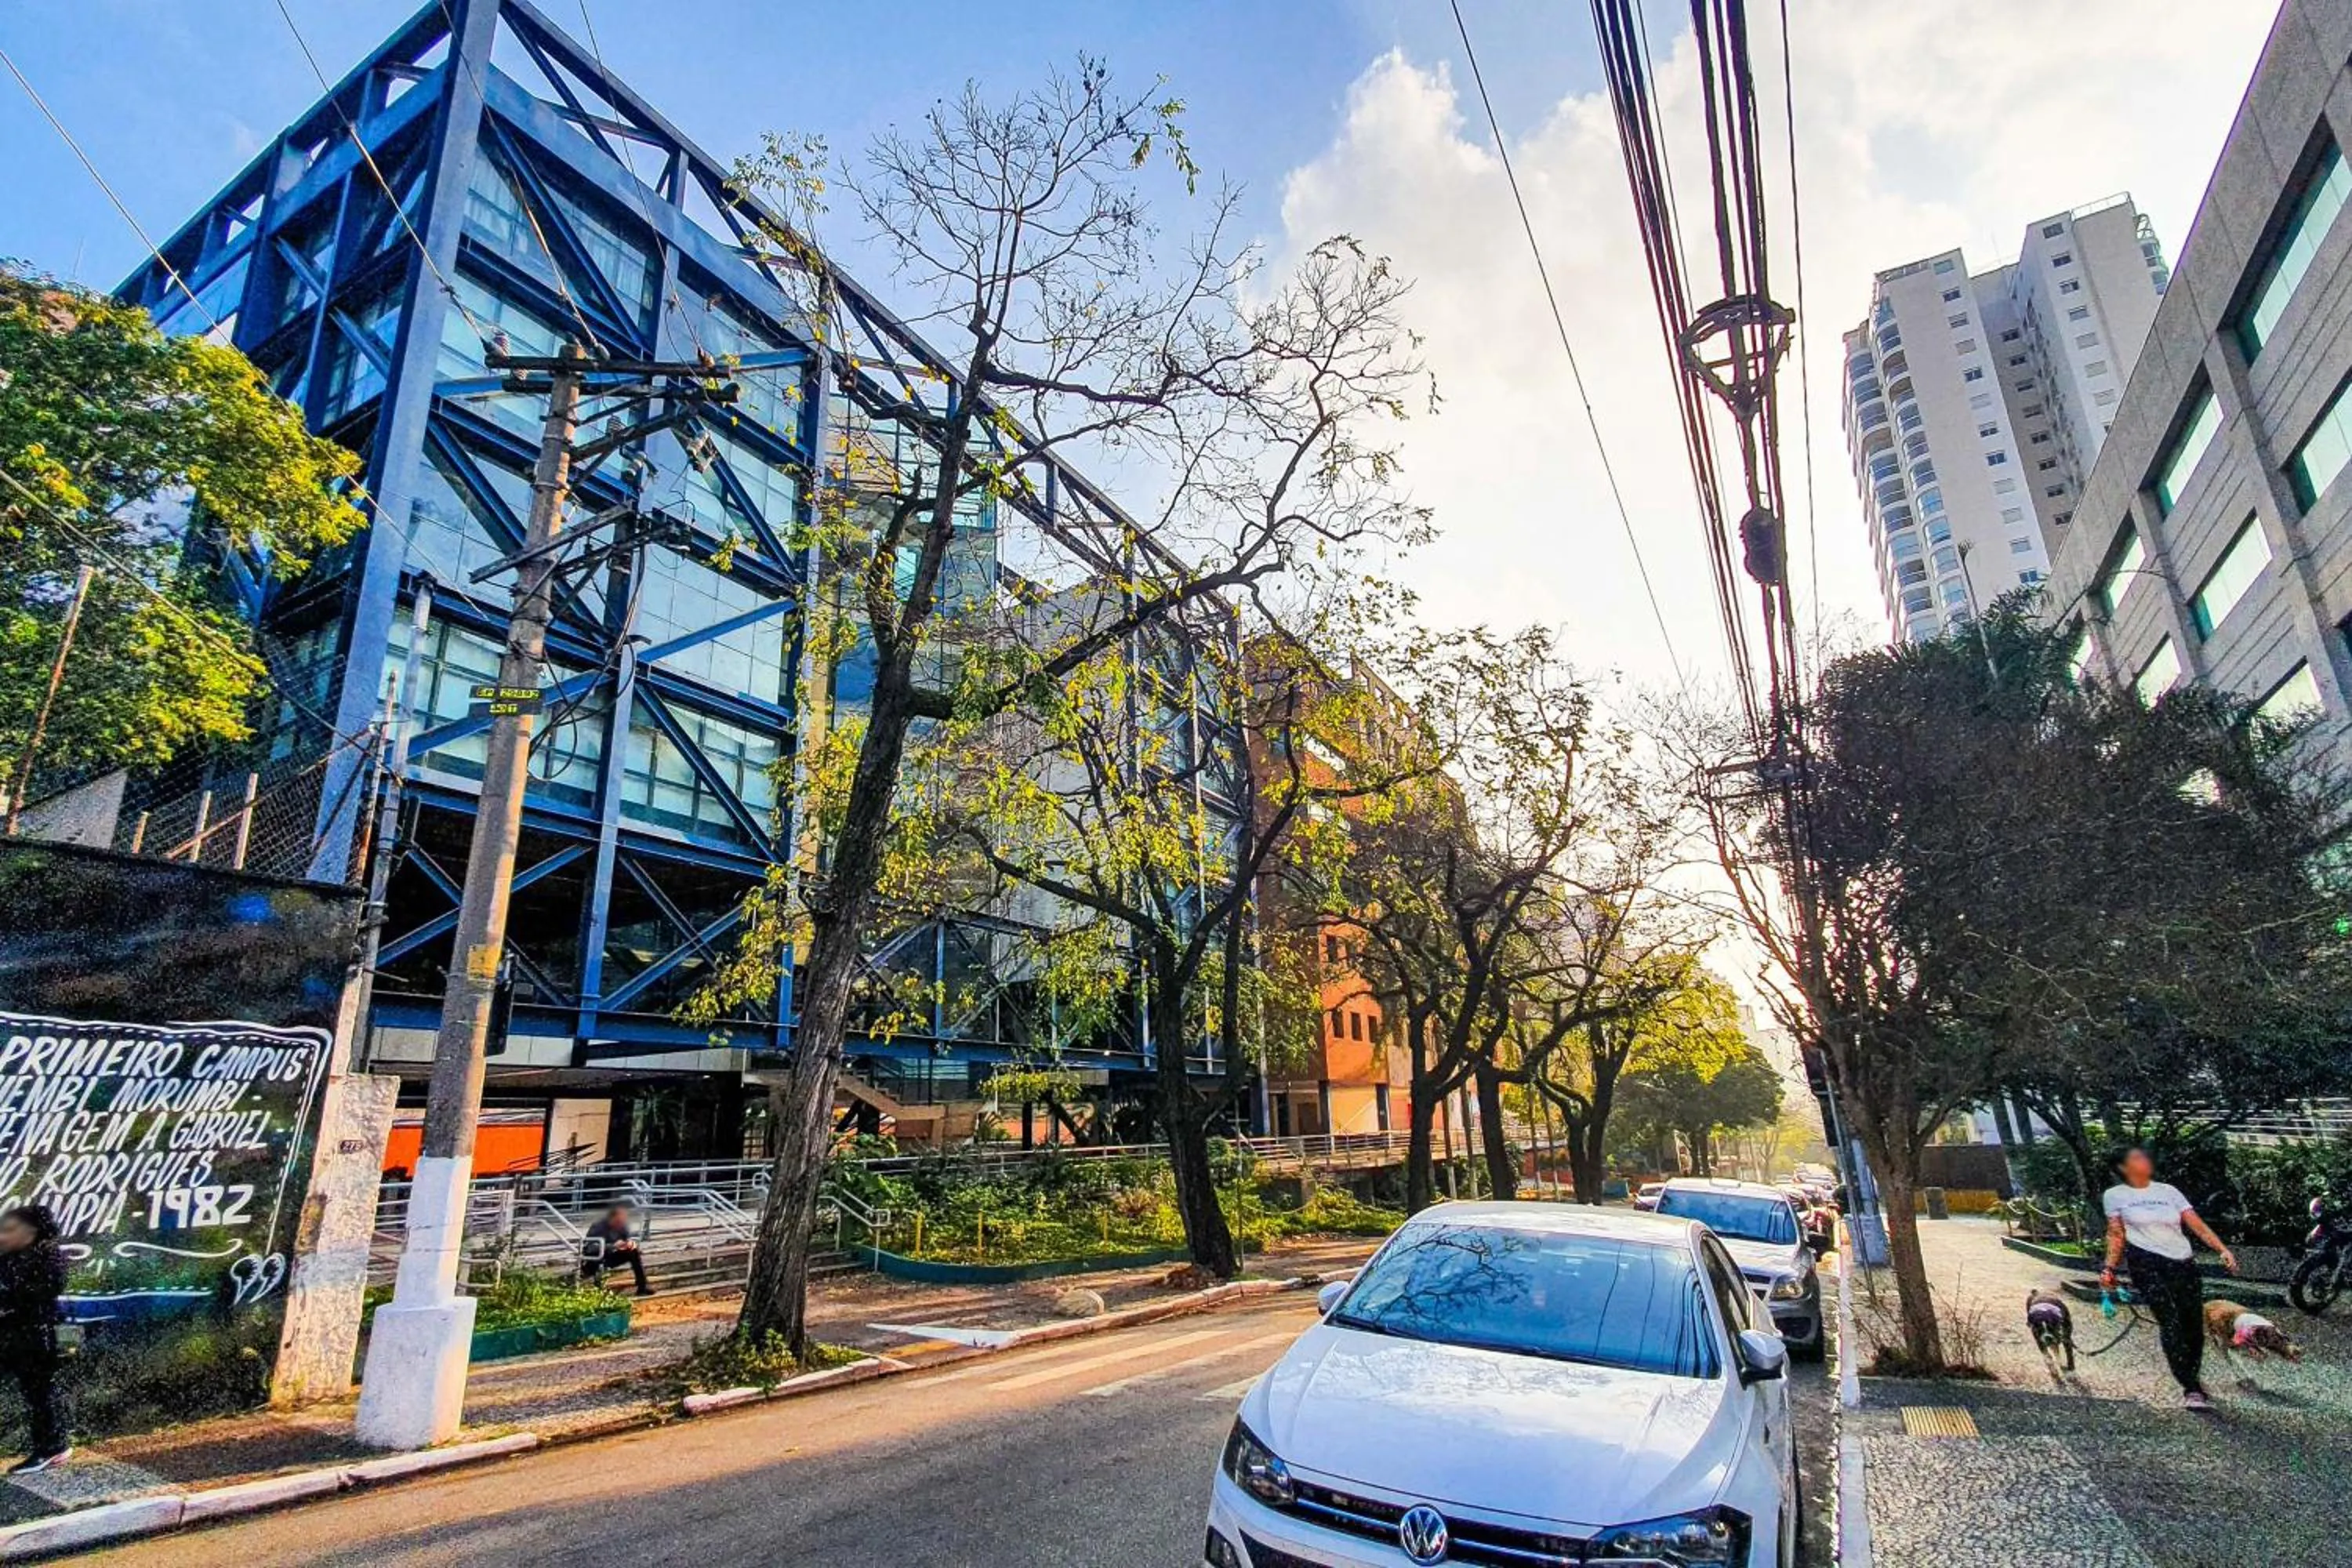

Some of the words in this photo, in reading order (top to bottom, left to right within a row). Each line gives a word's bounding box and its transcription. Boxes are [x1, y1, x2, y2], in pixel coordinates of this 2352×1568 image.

[0, 1035, 183, 1078] PRIMEIRO
[192, 1044, 309, 1081] CAMPUS
[108, 1077, 249, 1112] MORUMBI
[0, 1110, 139, 1156] ENAGEM
[137, 1111, 167, 1152] A
[169, 1109, 273, 1150] GABRIEL
[31, 1150, 216, 1197] RODRIGUES
[147, 1184, 255, 1229] 1982
